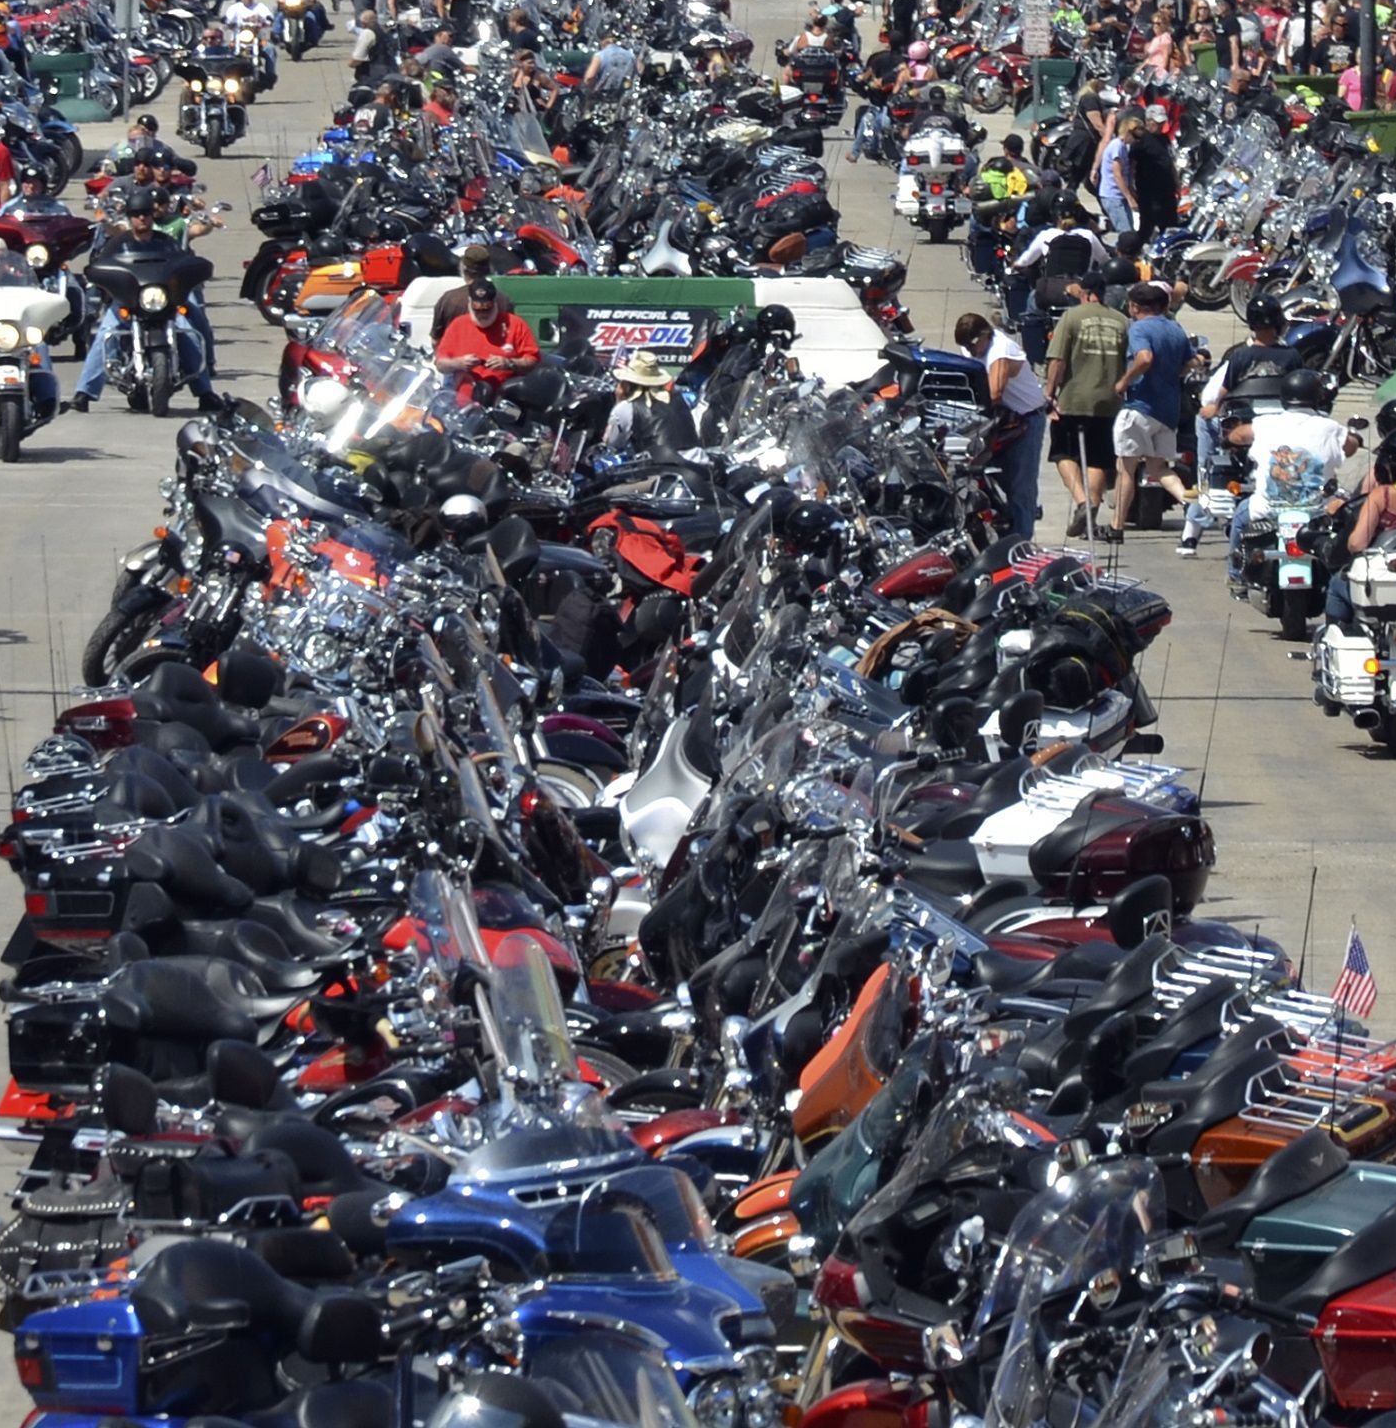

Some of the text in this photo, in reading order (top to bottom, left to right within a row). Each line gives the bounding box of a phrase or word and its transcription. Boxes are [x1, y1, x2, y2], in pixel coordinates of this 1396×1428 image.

[587, 309, 691, 320] THE OFFICIAL OIL
[589, 323, 693, 349] AMSOIL
